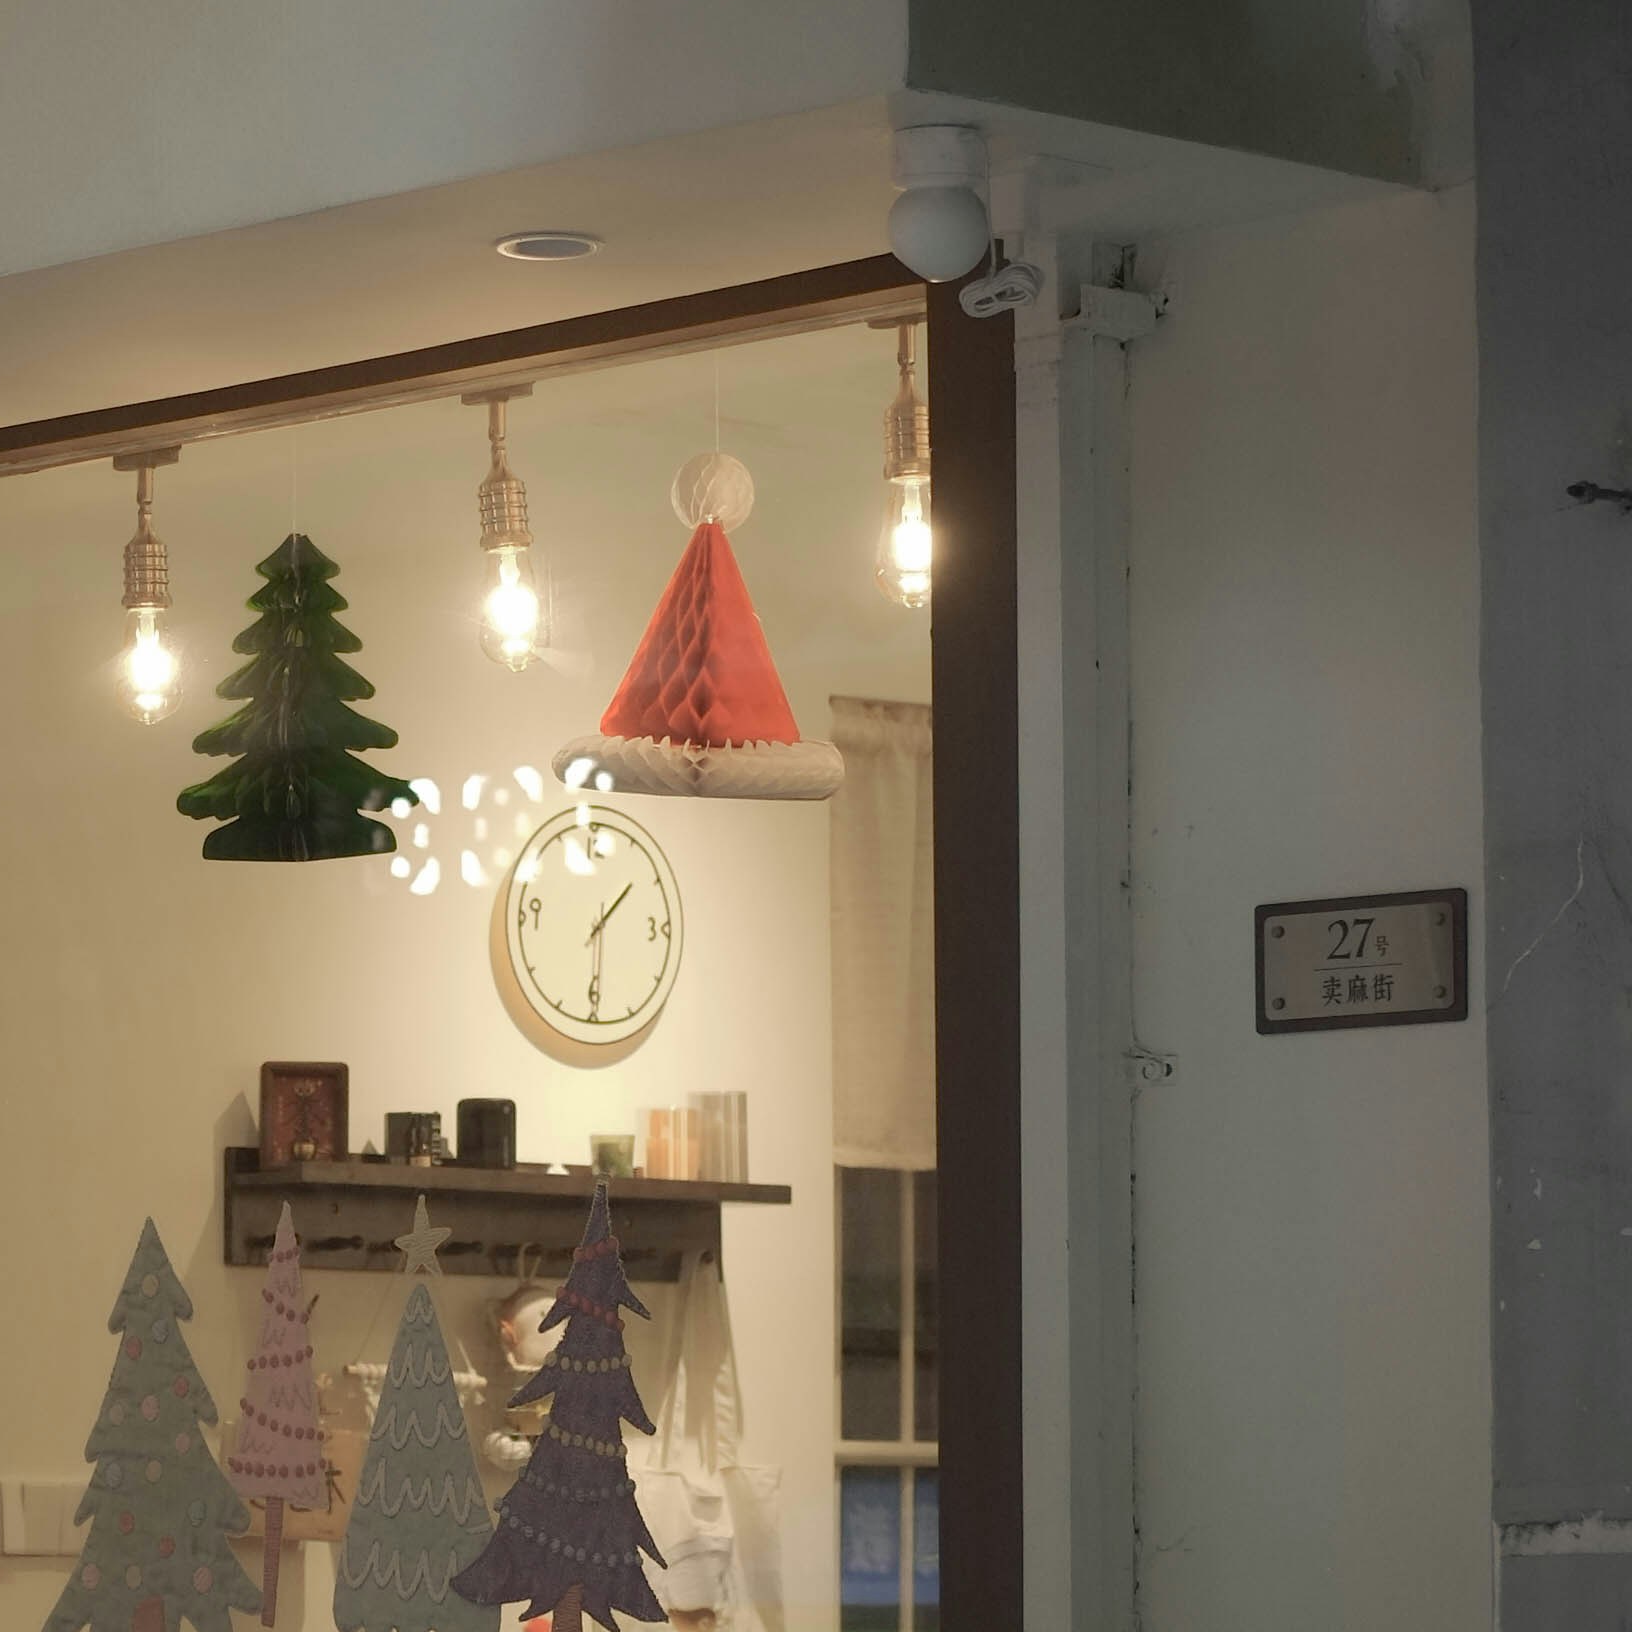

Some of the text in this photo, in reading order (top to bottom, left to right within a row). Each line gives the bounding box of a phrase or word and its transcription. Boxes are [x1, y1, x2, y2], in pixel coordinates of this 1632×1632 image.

[647, 916, 658, 941] 3
[1327, 917, 1390, 960] 27号
[1322, 974, 1395, 1007] 卖麻街
